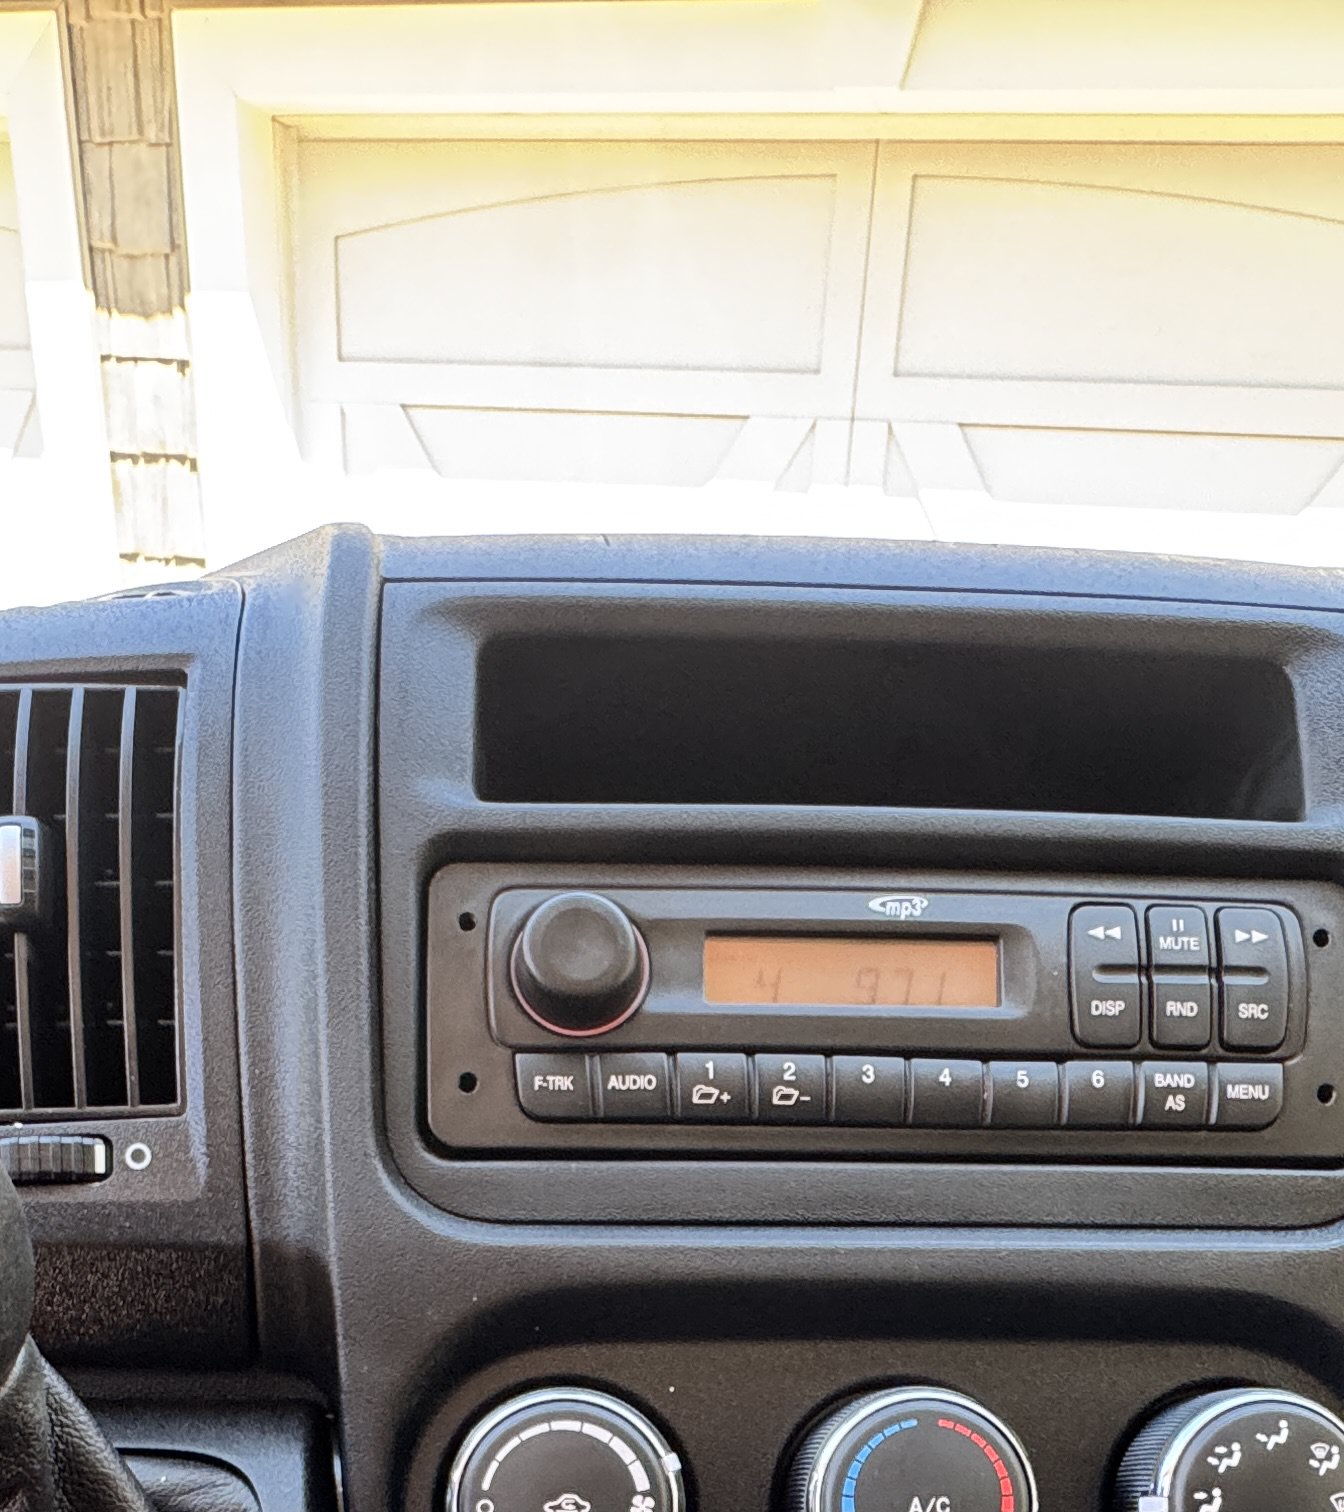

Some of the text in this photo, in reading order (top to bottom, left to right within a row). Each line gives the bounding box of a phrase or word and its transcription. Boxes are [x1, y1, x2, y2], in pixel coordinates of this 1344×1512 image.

[885, 900, 923, 921] mp3
[1159, 936, 1200, 951] MUTE
[1090, 1000, 1125, 1016] DISP
[1166, 1001, 1198, 1017] RND
[1238, 1003, 1269, 1020] SRC
[705, 1061, 715, 1080] 1
[782, 1061, 797, 1081] 2
[861, 1064, 875, 1084] 3
[938, 1068, 952, 1087] 4
[1016, 1070, 1030, 1088] 5
[1091, 1070, 1105, 1088] 6
[534, 1076, 574, 1091] F-TRK
[607, 1075, 657, 1091] AUDIO
[1154, 1073, 1196, 1088] BAND
[1226, 1083, 1270, 1100] MENU
[1164, 1095, 1186, 1111] AS
